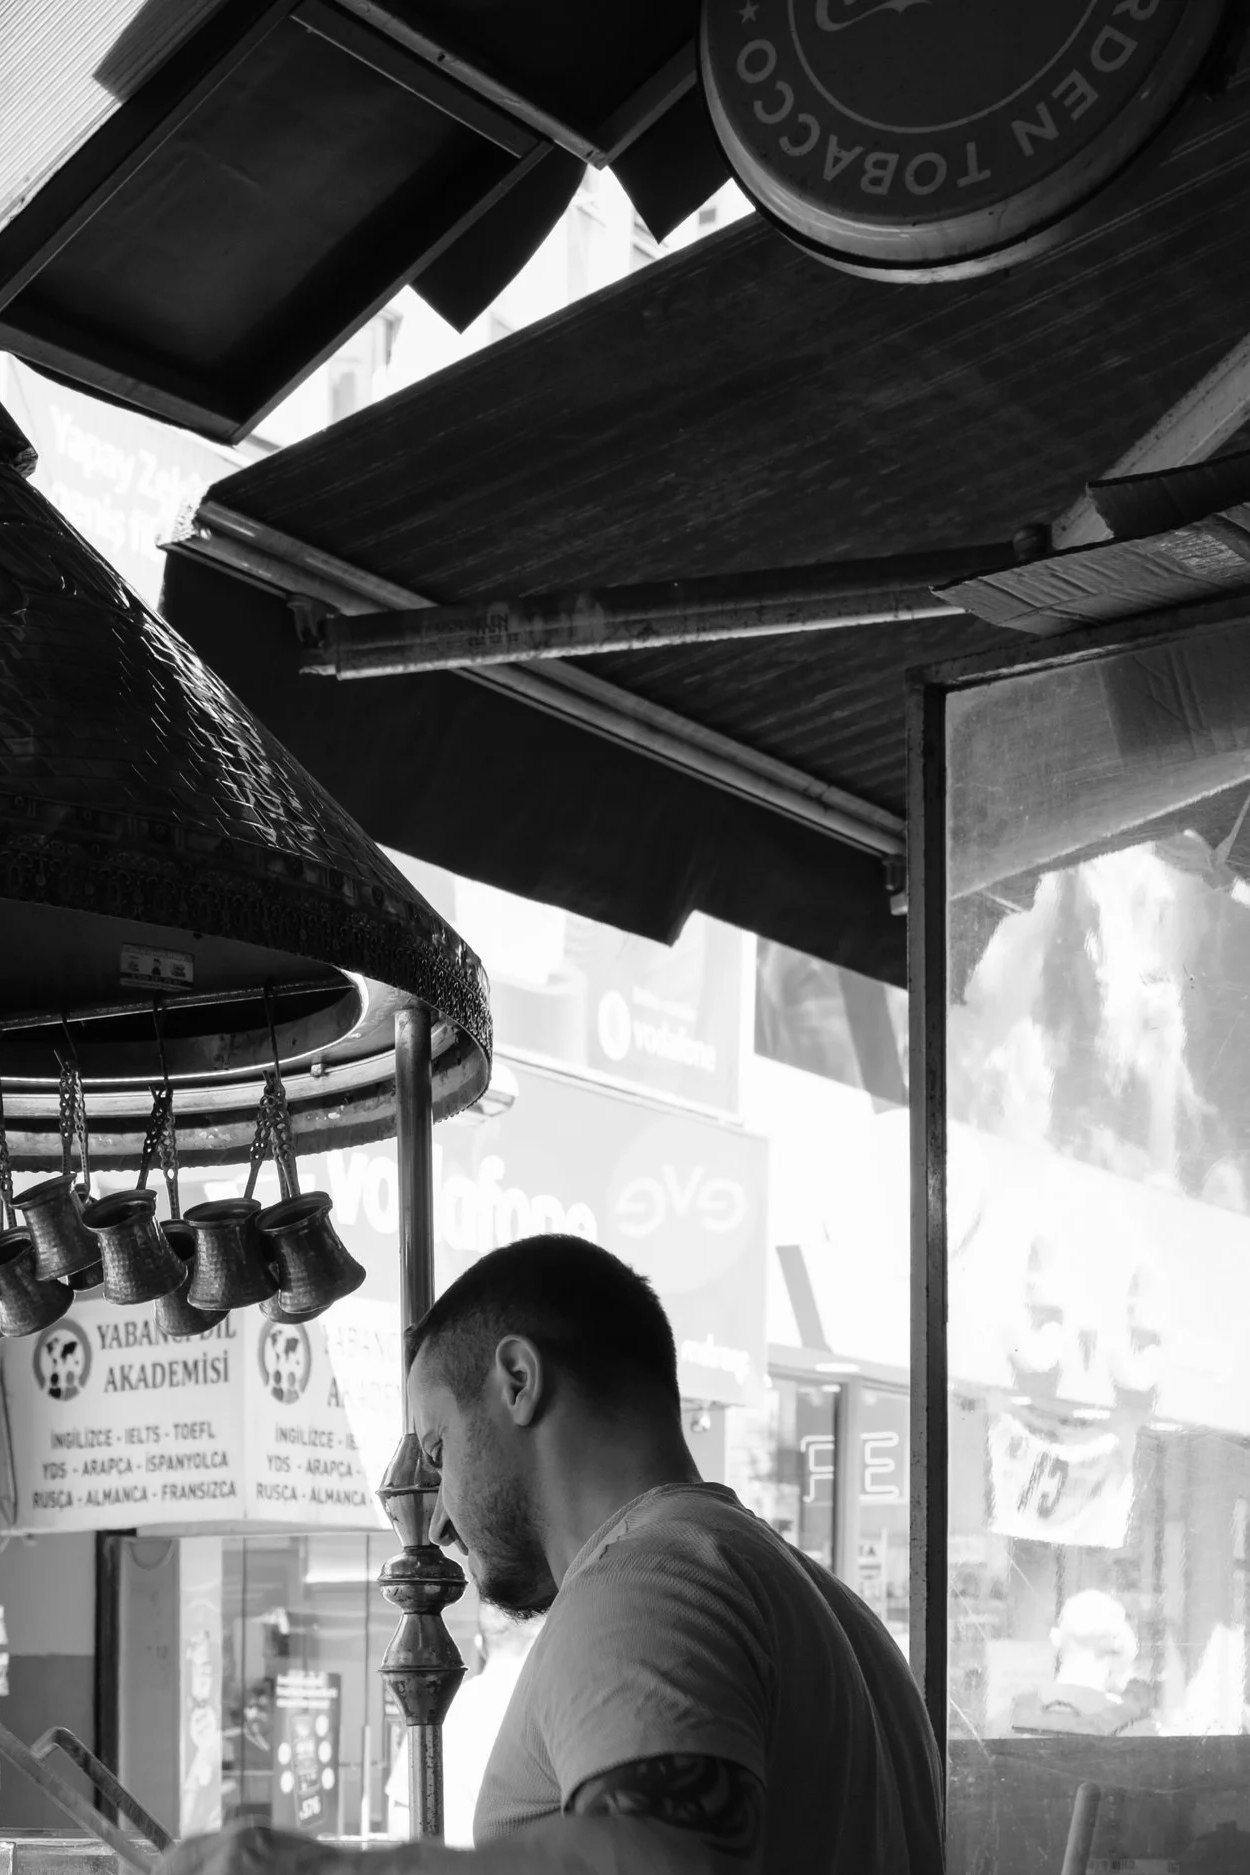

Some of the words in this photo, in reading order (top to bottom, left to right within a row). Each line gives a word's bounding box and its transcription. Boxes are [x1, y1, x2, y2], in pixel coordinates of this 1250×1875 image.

[736, 38, 991, 196] TOBACCO
[104, 1350, 230, 1393] AKADEMİSİ
[51, 1427, 113, 1449] İNGİLİZCE
[124, 1424, 160, 1446] IELTS
[173, 1420, 216, 1441] TOEFL
[81, 1454, 133, 1477] ARAPÇA
[85, 1484, 148, 1507] ALMANCA
[309, 1486, 367, 1507] ALMANCA
